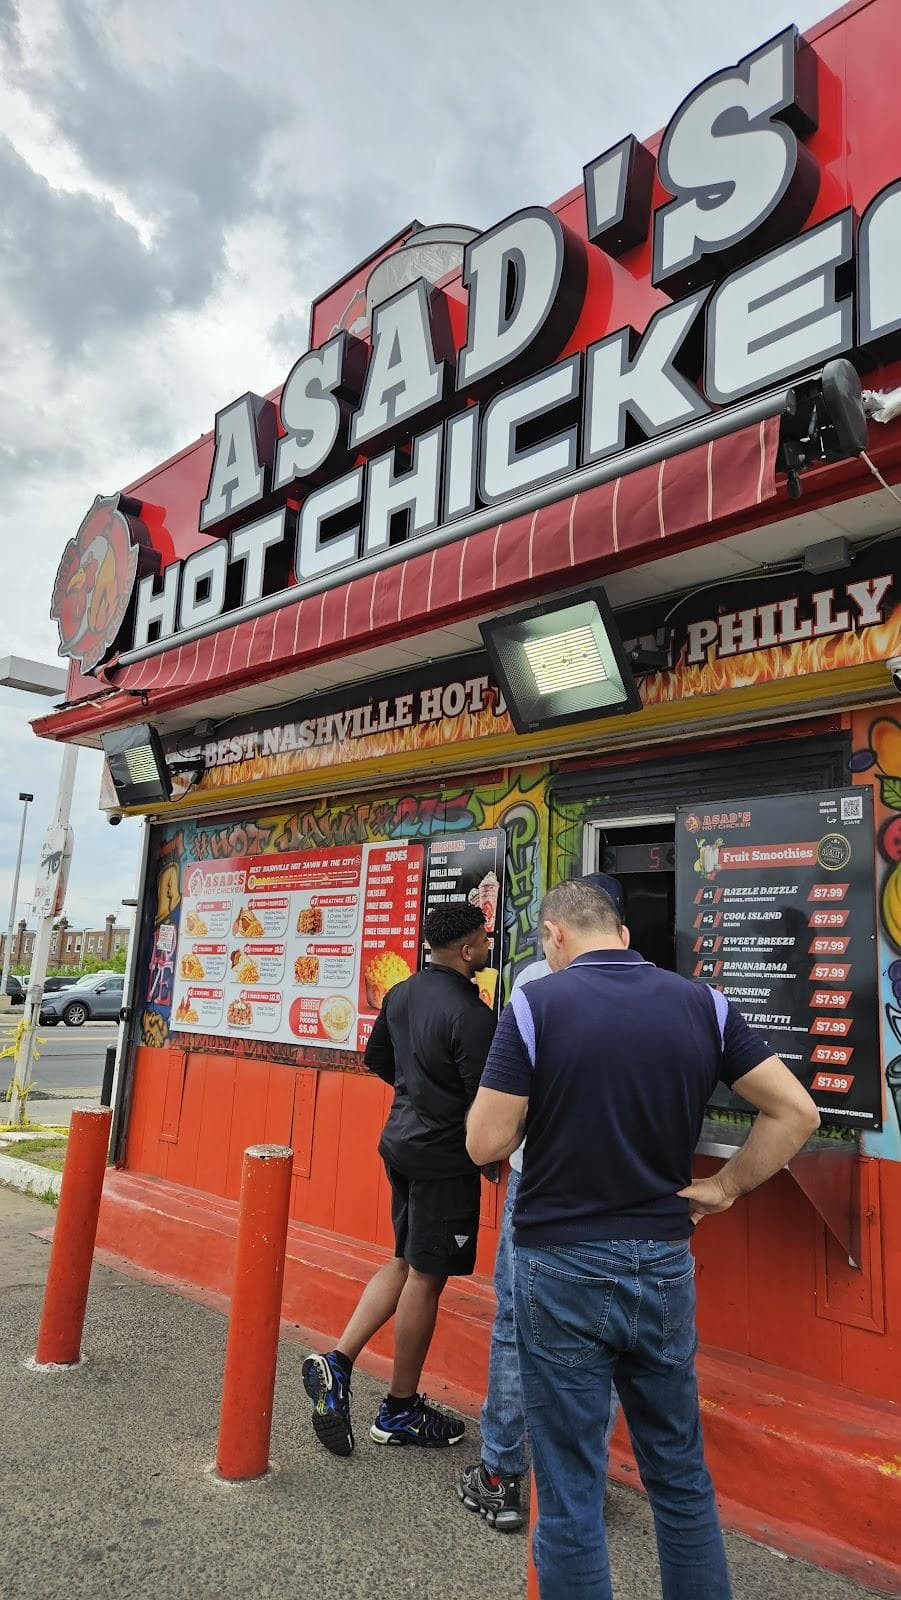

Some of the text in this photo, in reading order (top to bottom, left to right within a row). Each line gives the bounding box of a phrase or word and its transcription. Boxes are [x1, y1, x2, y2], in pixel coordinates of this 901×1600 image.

[199, 23, 800, 533] ASAD'S
[132, 502, 288, 652] HOT
[686, 574, 894, 664] PHILLY
[204, 731, 260, 769] BEST
[263, 694, 414, 758] NASHVILLE
[418, 675, 490, 723] HOT
[703, 811, 751, 826] ASAD'S
[384, 850, 408, 862] SIDES
[722, 847, 813, 863] Fruit Smoothies
[204, 870, 246, 888] ASAD'S
[723, 887, 760, 896] RAZZLE
[760, 885, 798, 895] DAZZLE
[814, 888, 843, 898] $7.99
[723, 912, 747, 920] COOL
[747, 911, 782, 920] ISLAND
[814, 914, 844, 924] $7.99
[723, 937, 757, 945] SWEET
[757, 937, 796, 946] BREEZE
[815, 941, 844, 950] $7.99
[723, 961, 788, 971] BANANARAMA
[815, 967, 845, 977] $7.99
[723, 986, 771, 997] SUNSHINE
[815, 994, 846, 1005] $7.99
[753, 1013, 792, 1024] FRUTTI
[816, 1021, 846, 1032] $7.99
[817, 1049, 847, 1061] $7.99
[817, 1076, 848, 1089] $7.99
